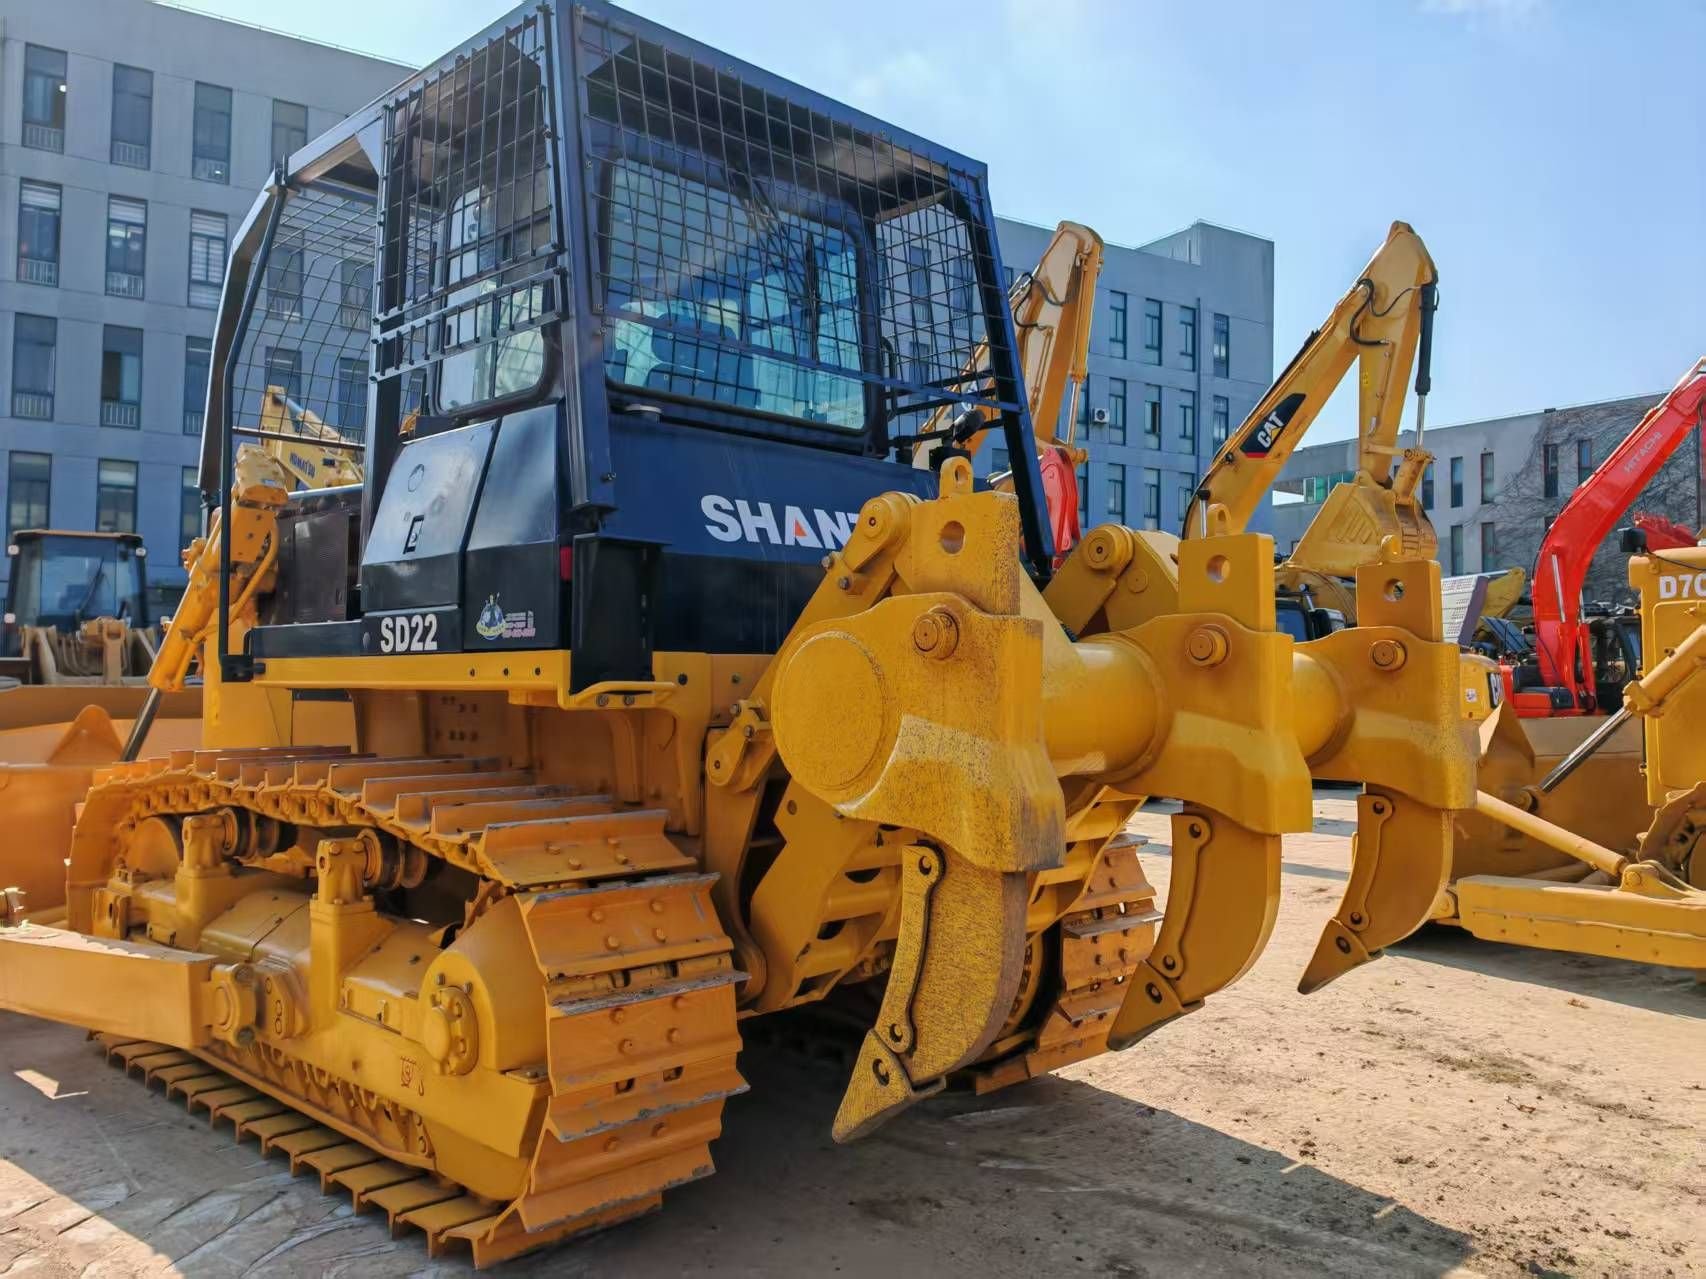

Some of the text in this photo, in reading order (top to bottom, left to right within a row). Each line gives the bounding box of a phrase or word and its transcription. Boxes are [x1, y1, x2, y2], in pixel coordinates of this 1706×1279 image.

[1257, 411, 1284, 448] CAT
[1624, 431, 1662, 472] HITACHI
[380, 613, 438, 653] SD22
